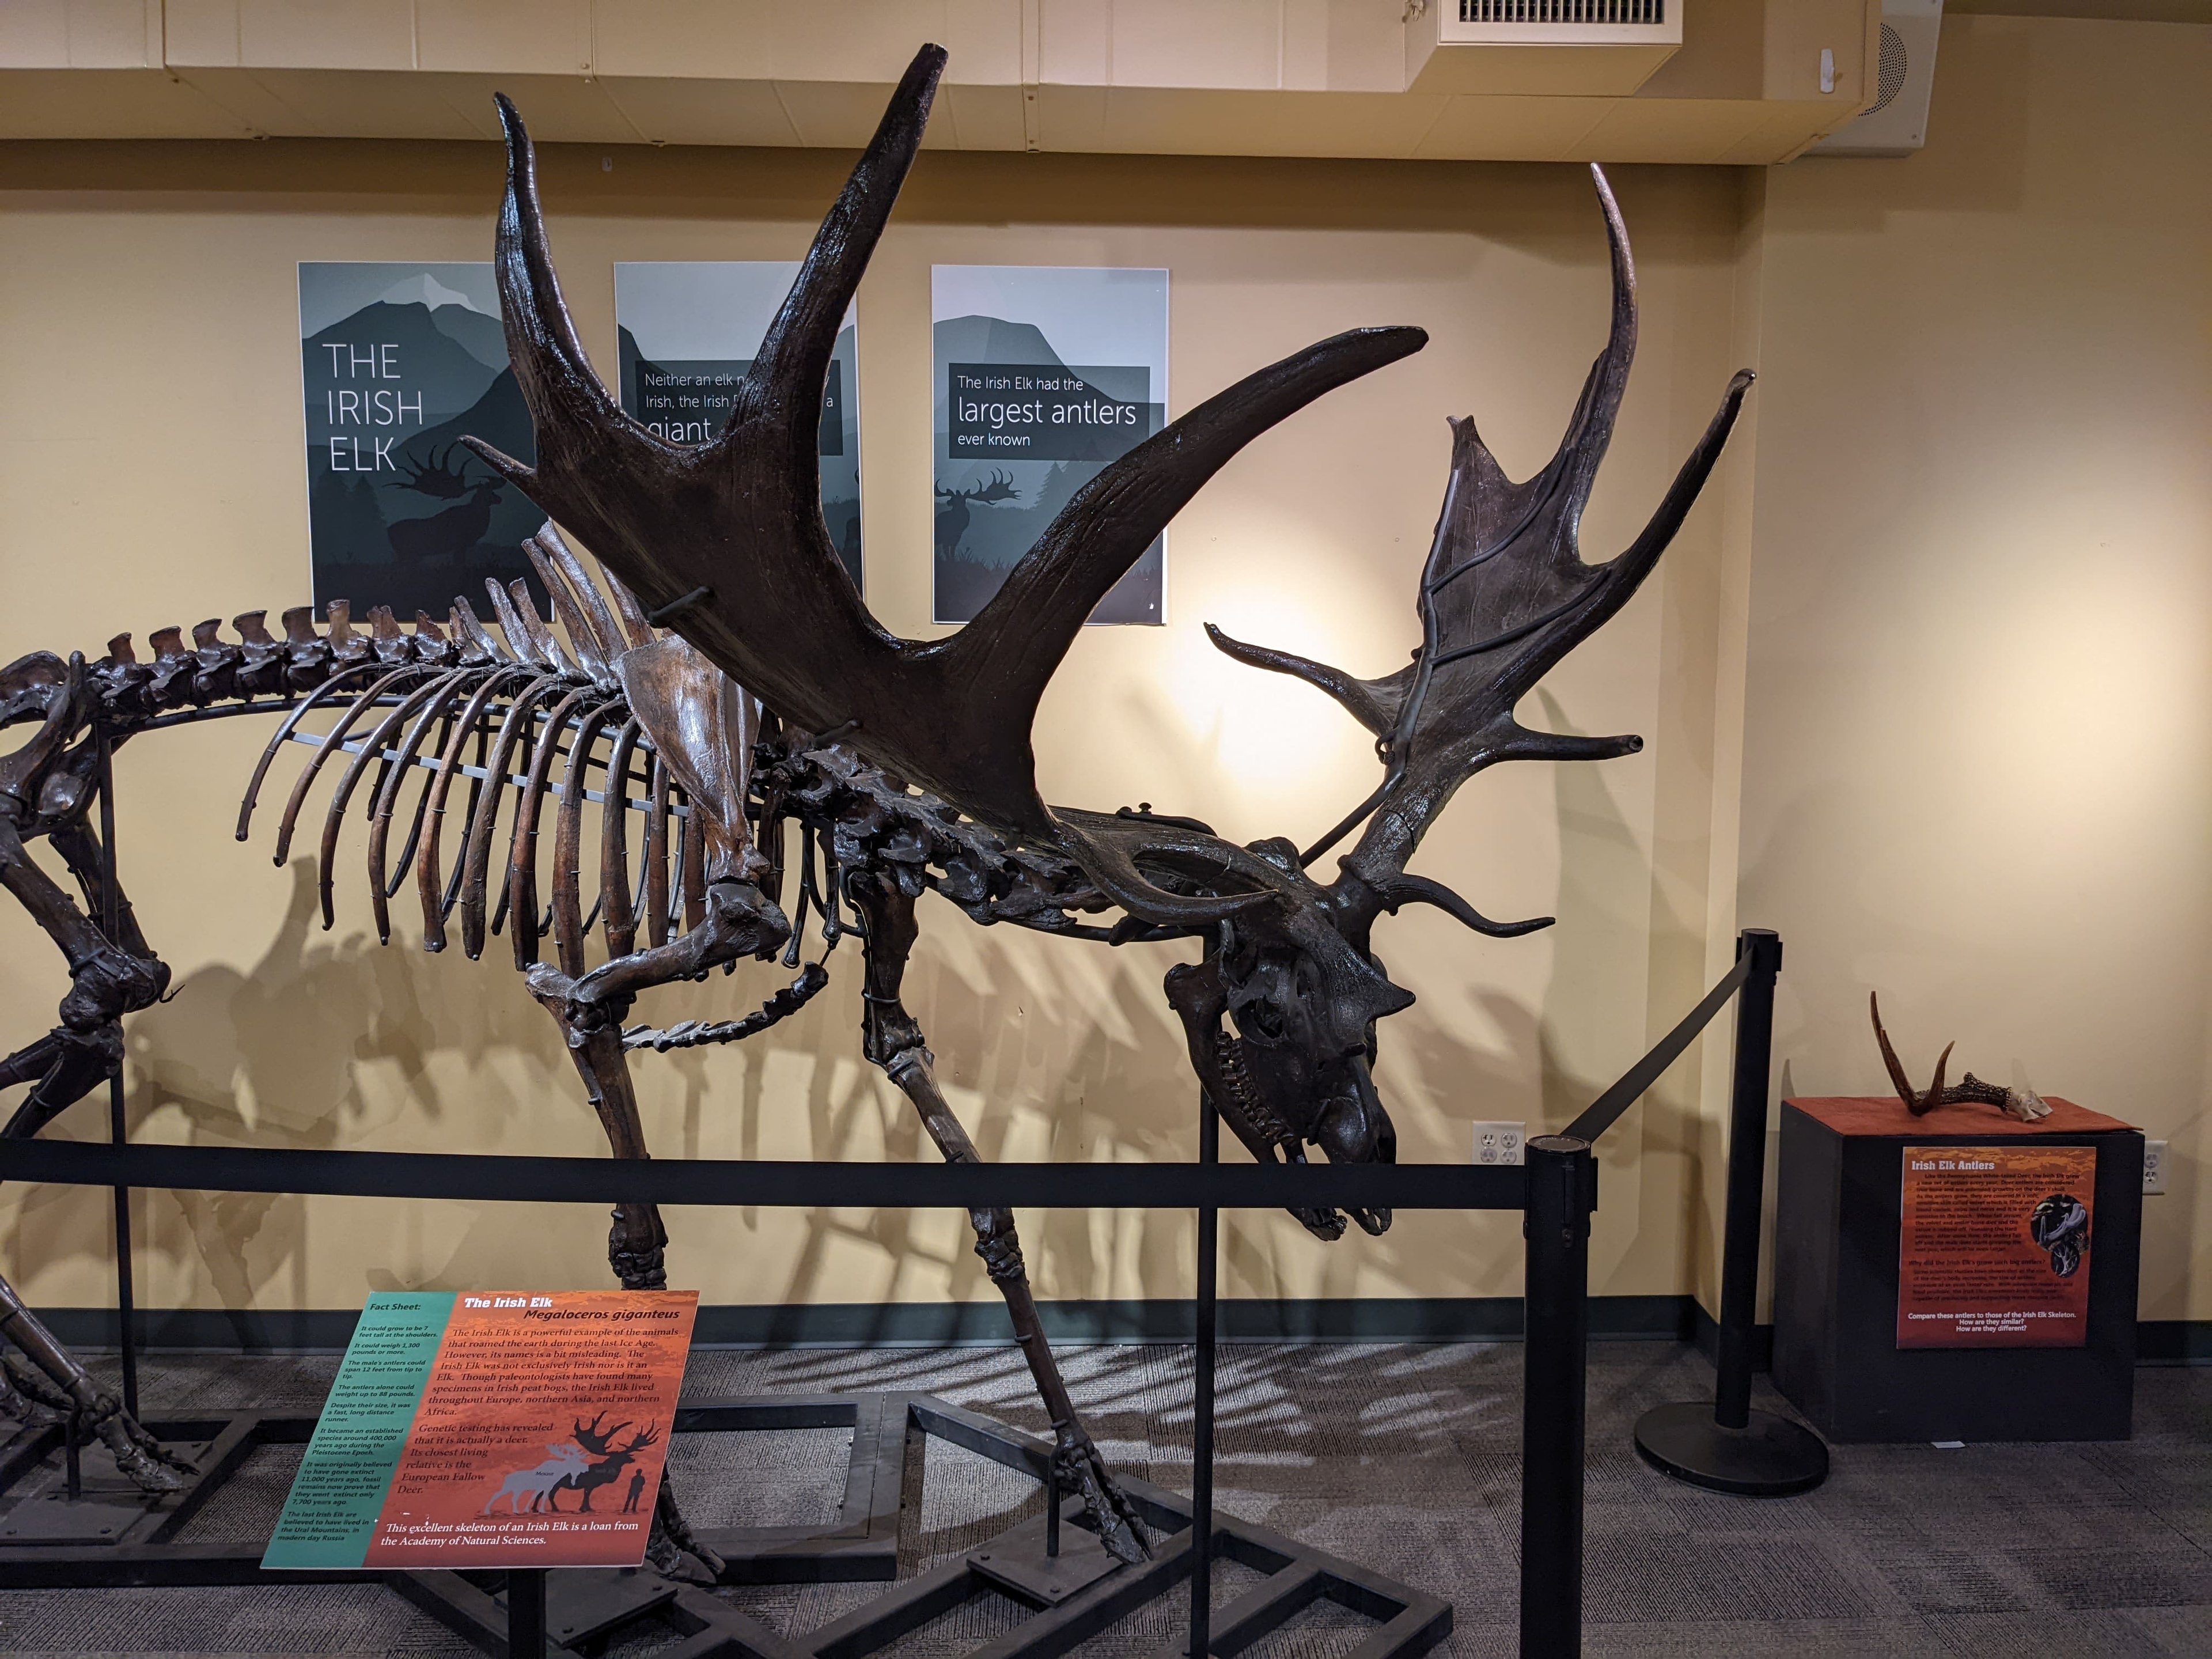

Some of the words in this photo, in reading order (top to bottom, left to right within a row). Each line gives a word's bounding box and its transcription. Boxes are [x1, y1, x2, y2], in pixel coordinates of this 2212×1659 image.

[322, 344, 401, 378] THE
[645, 373, 691, 386] Neither
[695, 376, 711, 386] an
[715, 373, 733, 386] elk
[957, 375, 982, 390] The
[985, 376, 1011, 391] Irish
[1015, 376, 1033, 391] Elk
[1036, 376, 1060, 391] had
[1063, 377, 1084, 391] the
[646, 395, 675, 409] Irish,
[679, 395, 699, 408] the
[703, 395, 729, 408] Irish
[826, 397, 834, 407] a
[328, 390, 423, 426] IRISH
[959, 397, 1043, 430] largest
[1051, 397, 1137, 425] antlers
[957, 435, 984, 446] ever
[988, 433, 1031, 446] known
[331, 437, 396, 471] ELK
[1911, 1160, 1936, 1170] Irish
[1938, 1160, 1955, 1170] Elk
[1958, 1160, 1995, 1170] Antlers
[464, 1297, 491, 1308] The
[494, 1297, 527, 1308] Irish
[530, 1297, 553, 1308] Elk
[524, 1309, 609, 1321] Megaloceros
[611, 1309, 680, 1321] giganteus
[530, 1328, 571, 1338] powerful
[574, 1328, 612, 1337] example
[550, 1339, 582, 1348] during
[635, 1339, 656, 1348] Age.
[444, 1351, 487, 1359] However,
[568, 1350, 622, 1359] misleading.
[521, 1361, 572, 1370] exclusively
[461, 1373, 496, 1382] Though
[498, 1372, 570, 1382] paleontologists
[432, 1384, 482, 1394] specimens
[521, 1384, 541, 1393] peat
[544, 1384, 569, 1393] bogs,
[429, 1396, 483, 1406] throughout
[486, 1396, 522, 1405] Europe,
[525, 1395, 568, 1403] northern
[571, 1395, 594, 1403] Asia,
[425, 1407, 457, 1415] Africa.
[387, 1523, 407, 1532] This
[409, 1523, 452, 1532] excellent
[455, 1522, 496, 1532] skeleton
[498, 1522, 512, 1531] of
[526, 1522, 550, 1531] Irish
[552, 1522, 569, 1531] Elk
[571, 1522, 579, 1531] is
[590, 1521, 611, 1530] loan
[614, 1521, 639, 1530] from
[381, 1537, 397, 1546] the
[399, 1536, 447, 1548] Academy
[449, 1536, 462, 1545] of
[461, 1535, 501, 1545] Natural
[502, 1535, 547, 1545] Sciences.
